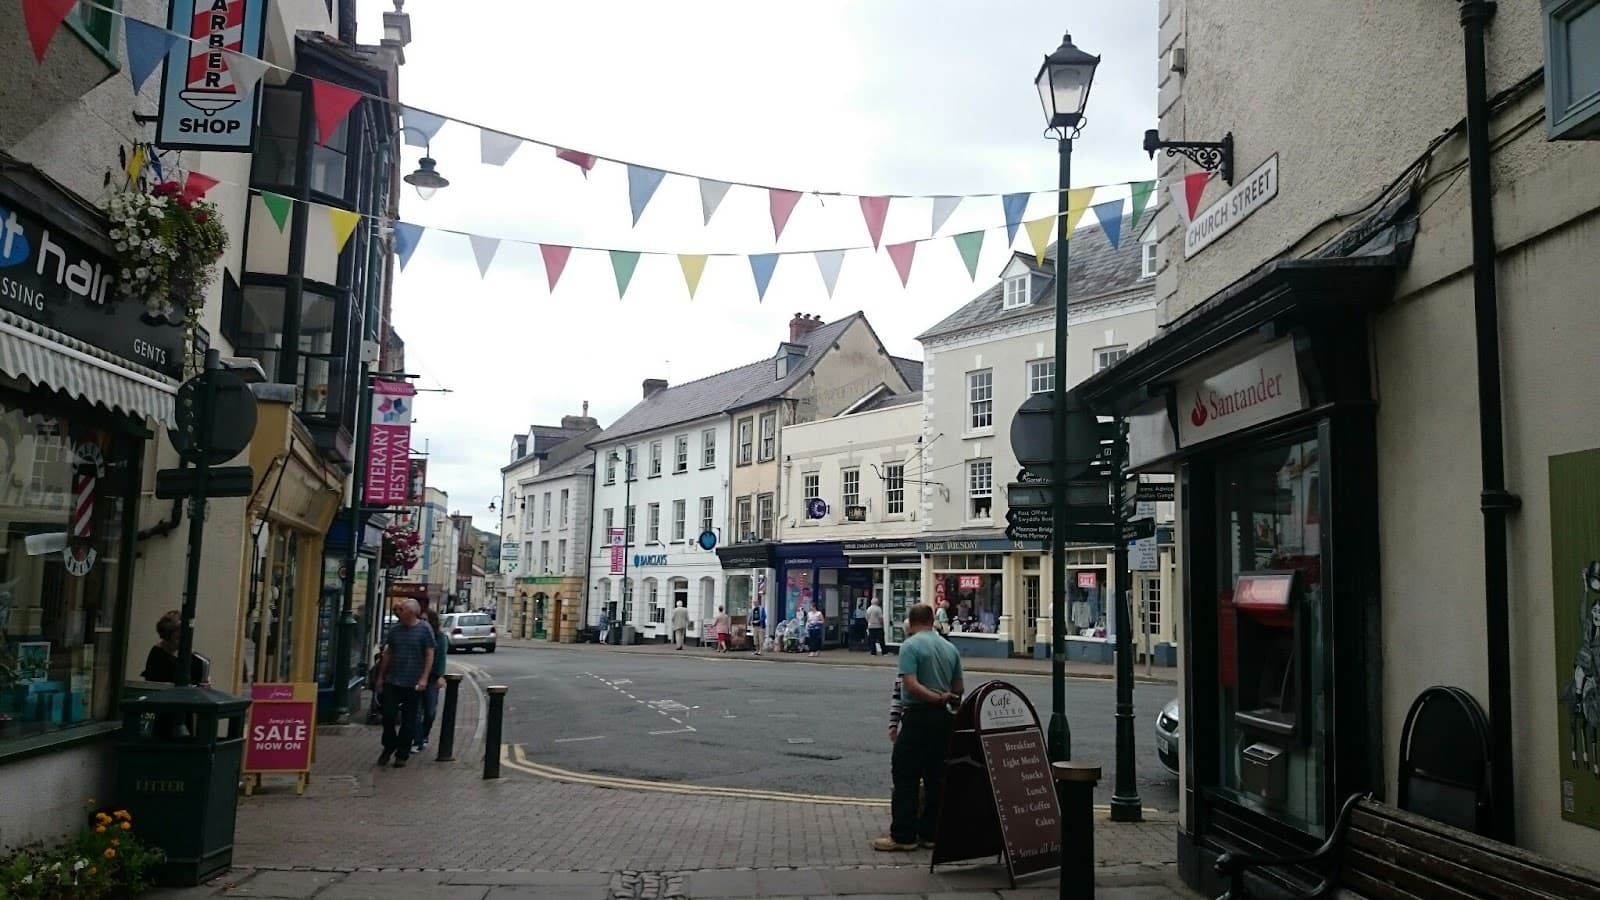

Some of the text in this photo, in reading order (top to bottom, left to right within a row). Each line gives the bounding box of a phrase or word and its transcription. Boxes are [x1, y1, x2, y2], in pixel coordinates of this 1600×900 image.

[179, 118, 240, 134] SHOP
[1188, 166, 1272, 248] CHURCH STREET
[37, 230, 114, 304] hair
[1, 277, 44, 311] SSING
[134, 339, 166, 365] GENTS
[1210, 367, 1283, 420] Santander
[369, 426, 389, 500] LITERARY
[389, 430, 408, 500] FESTIVAL
[948, 541, 978, 550] TUESDAY
[641, 555, 667, 566] BARCLAYS
[960, 580, 979, 588] SALE
[1079, 576, 1096, 585] SALE
[253, 726, 306, 741] SALE
[285, 742, 301, 750] ON
[1005, 741, 1036, 752] Breakfast
[1003, 756, 1040, 769] Light Meals
[1021, 770, 1044, 781] Snacks
[136, 779, 185, 793] LITTER
[1026, 785, 1047, 797] Lunch
[1013, 805, 1025, 815] Tea
[1029, 801, 1051, 812] Coffee
[1035, 817, 1056, 827] Cakes
